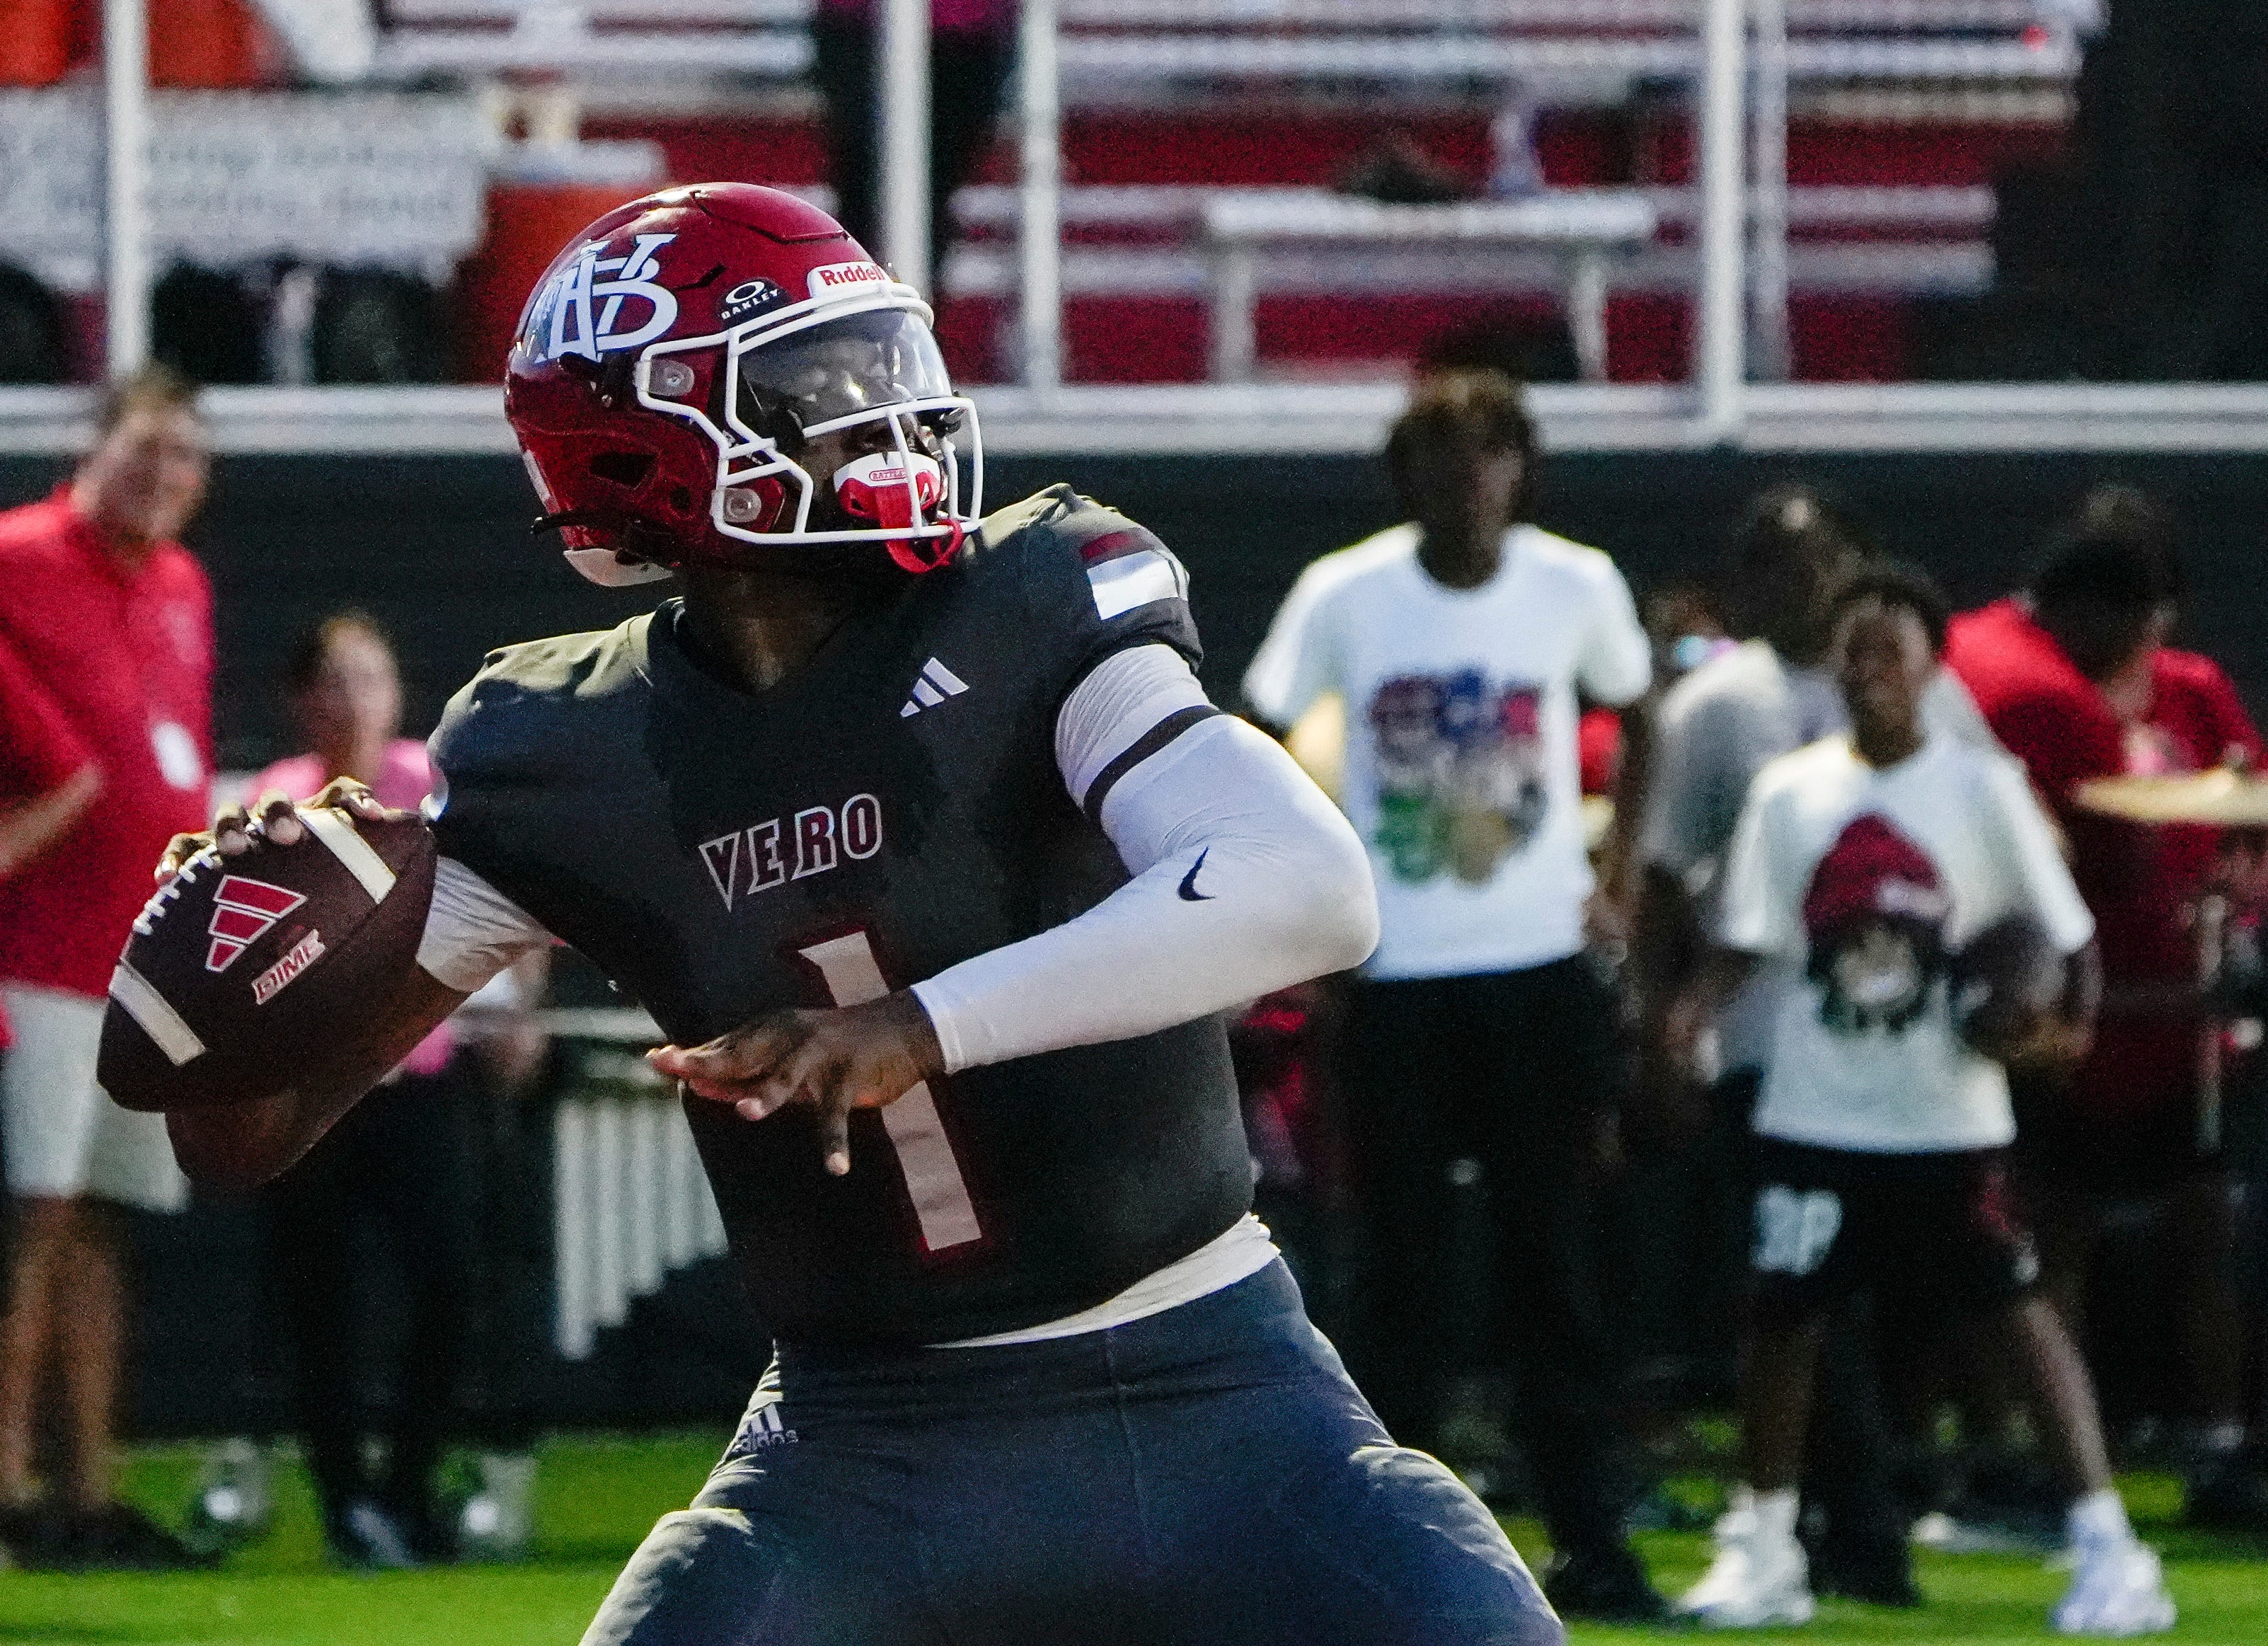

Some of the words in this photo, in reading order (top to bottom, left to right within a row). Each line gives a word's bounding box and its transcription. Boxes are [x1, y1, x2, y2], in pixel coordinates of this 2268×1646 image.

[720, 288, 780, 320] OAKLEY
[818, 265, 885, 286] Riddell
[697, 793, 884, 913] VERO
[795, 928, 984, 1253] 1
